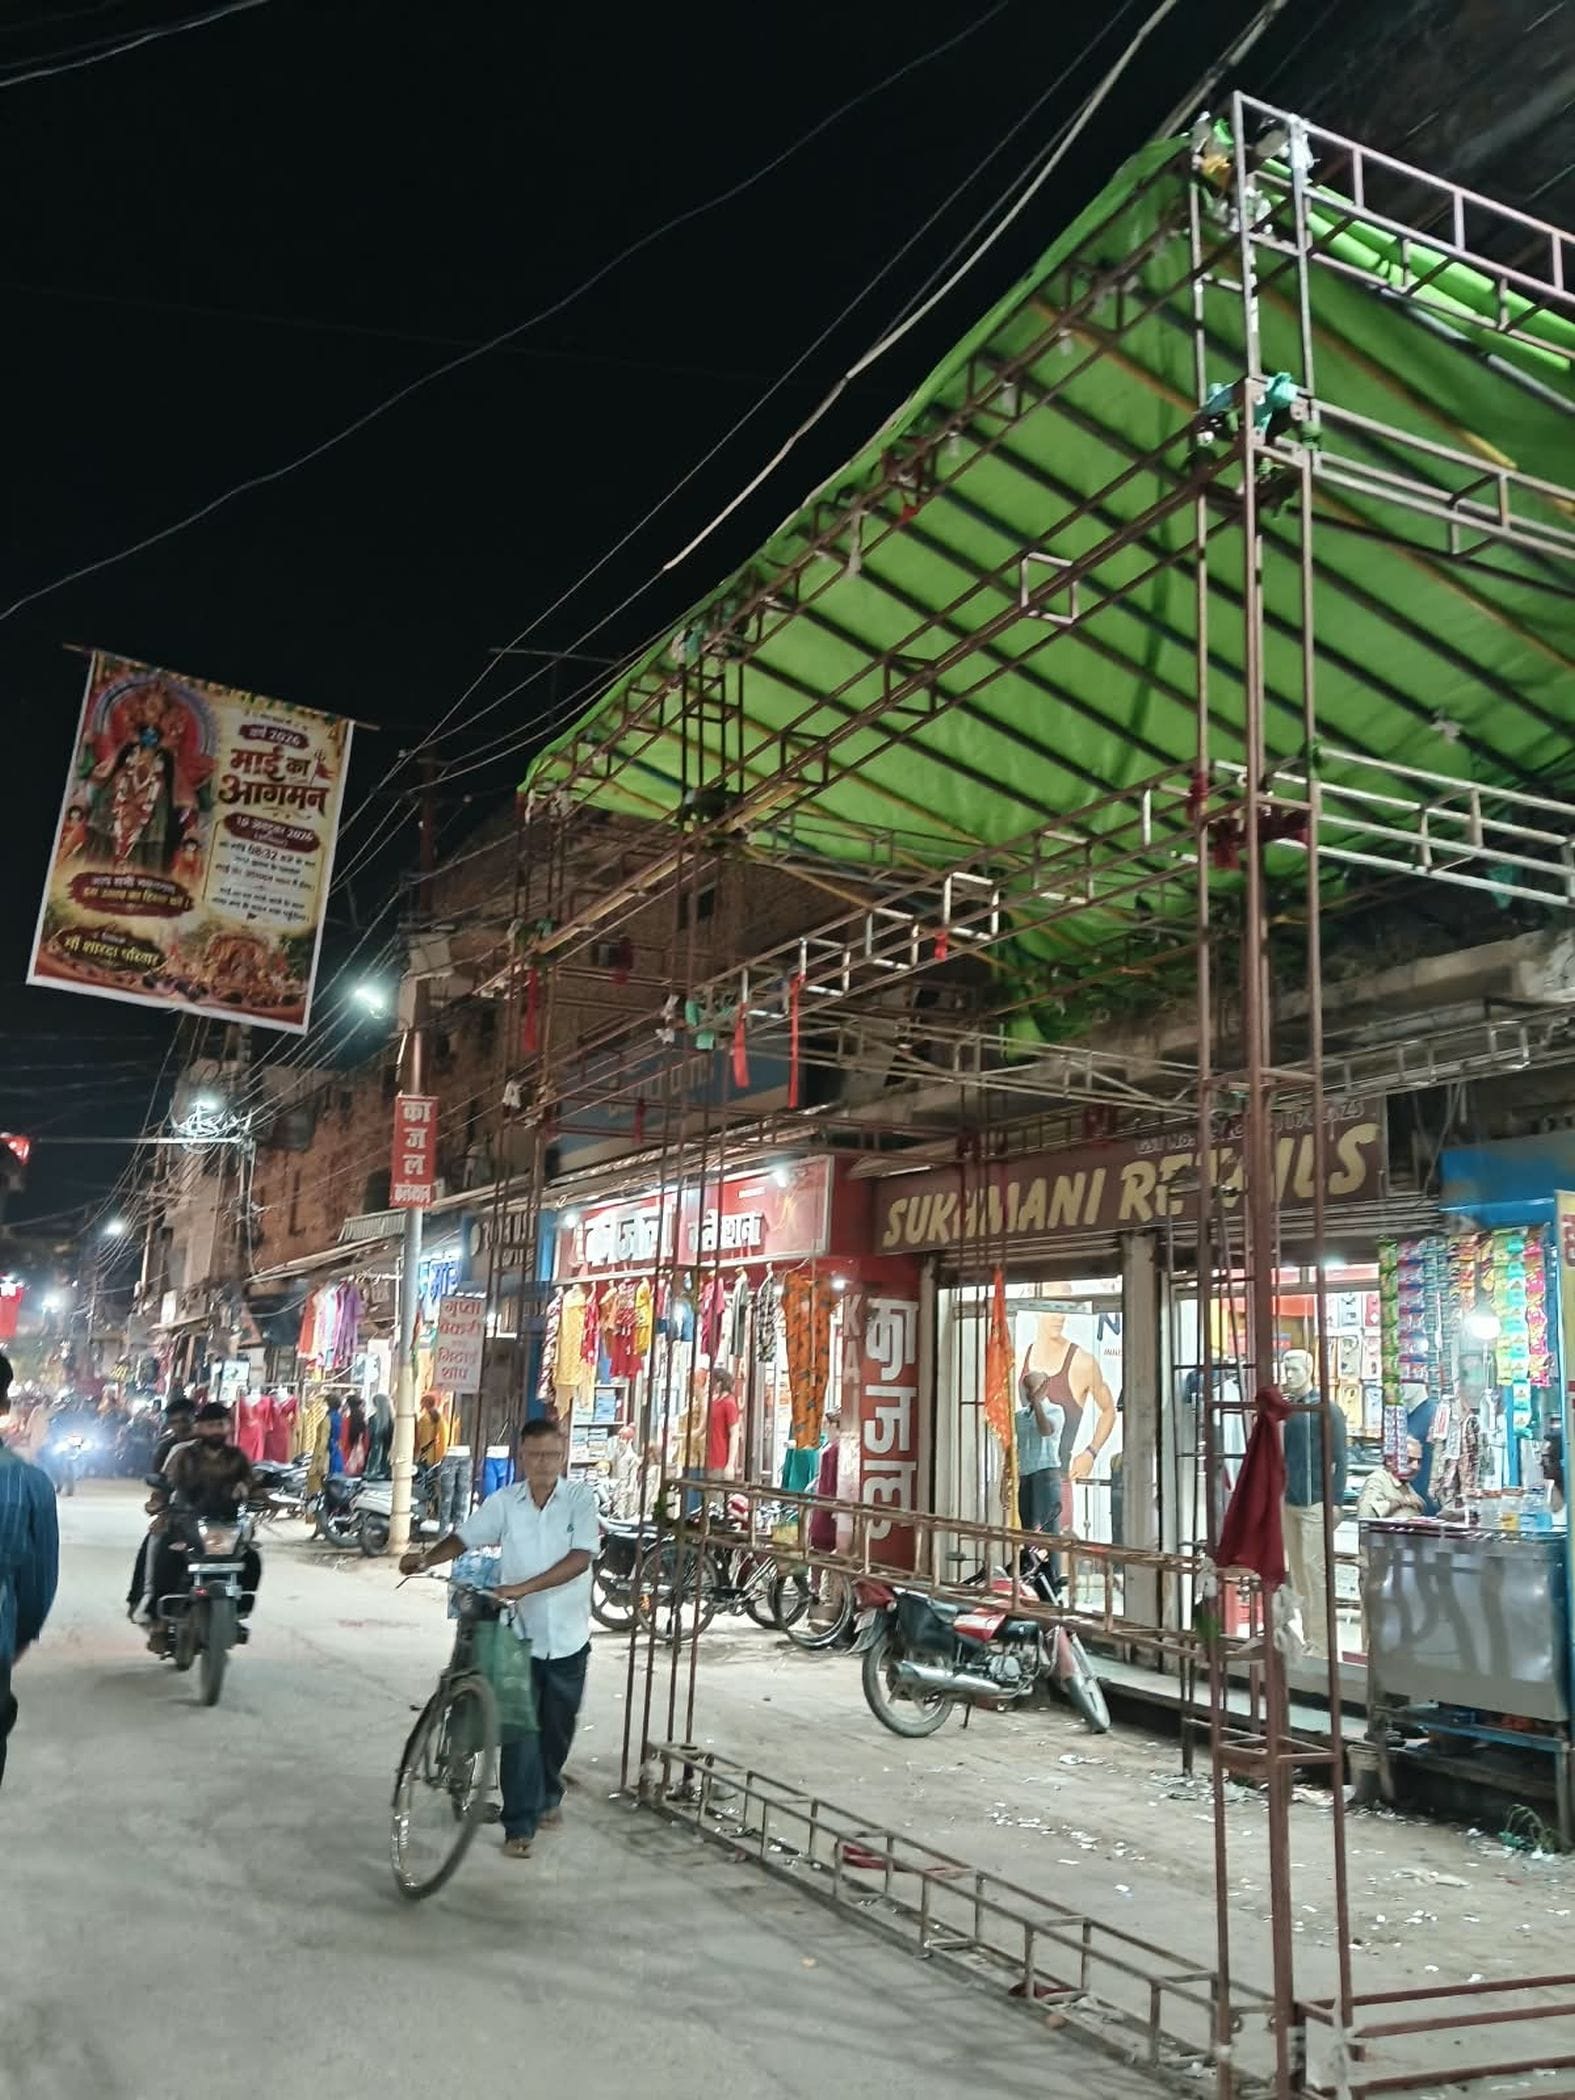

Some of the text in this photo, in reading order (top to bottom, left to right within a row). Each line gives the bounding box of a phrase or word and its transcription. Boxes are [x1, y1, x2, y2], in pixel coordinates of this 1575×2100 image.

[230, 745, 311, 781] माई का
[218, 774, 330, 816] आगमन
